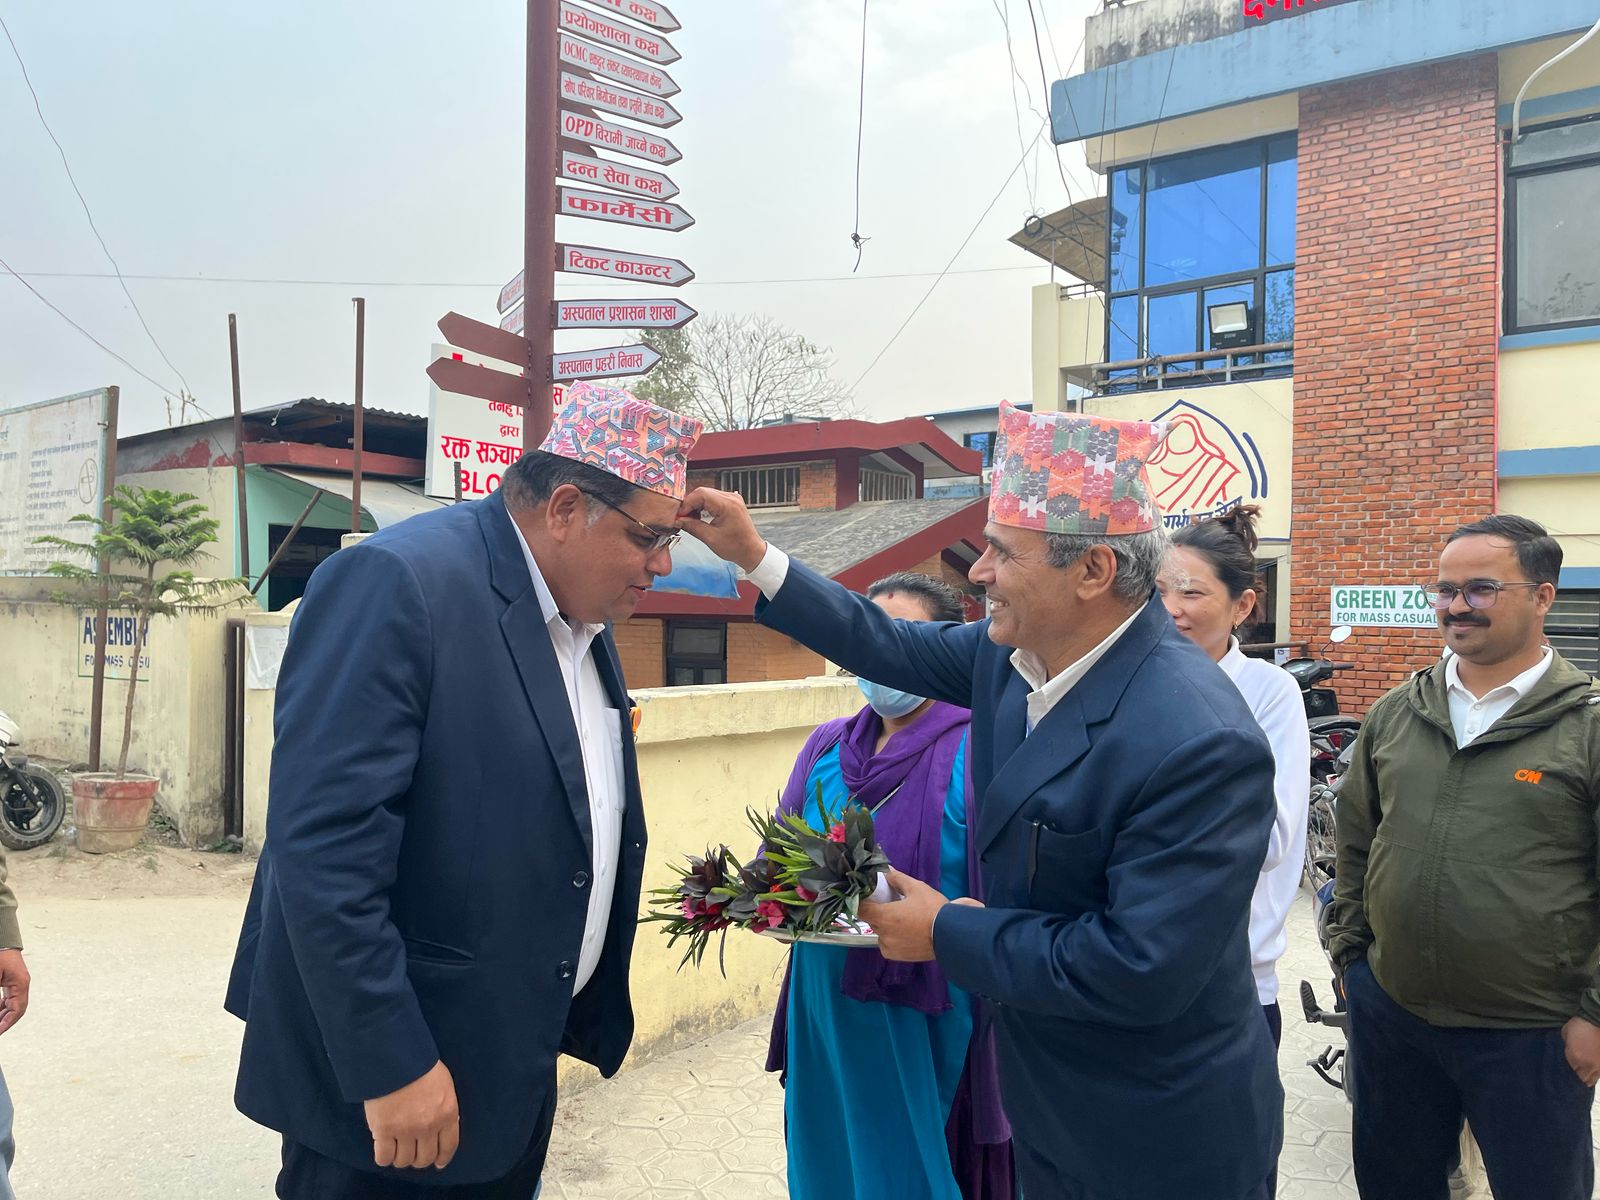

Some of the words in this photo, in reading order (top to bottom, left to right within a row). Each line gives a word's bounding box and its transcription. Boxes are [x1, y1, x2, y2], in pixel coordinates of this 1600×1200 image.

[629, 3, 657, 22] कक्ष
[565, 10, 630, 45] प्रयोगशाला
[635, 36, 660, 55] कक्ष
[564, 41, 588, 63] OCMC
[566, 116, 593, 137] OPD
[650, 140, 666, 158] कक्ष
[567, 159, 598, 179] दन्त
[603, 167, 629, 186] सेवा
[635, 176, 662, 194] कक्ष
[569, 250, 610, 271] टिकट
[615, 260, 673, 280] काउन्टर
[562, 306, 605, 321] अस्पताल
[609, 306, 645, 322] प्रशासन
[650, 306, 677, 321] शाखा
[558, 358, 592, 375] अस्पताल
[595, 352, 616, 372] प्रहरी
[618, 352, 643, 369] निवास
[500, 425, 519, 437] द्वारा
[441, 436, 471, 459] रक्त
[460, 470, 502, 494] BLO
[1336, 590, 1396, 609] GREEN
[1402, 590, 1432, 609] ZO
[1337, 612, 1356, 622] FOR
[1360, 613, 1390, 623] MASS
[1394, 613, 1437, 624] CASUAL
[105, 655, 123, 667] MASS
